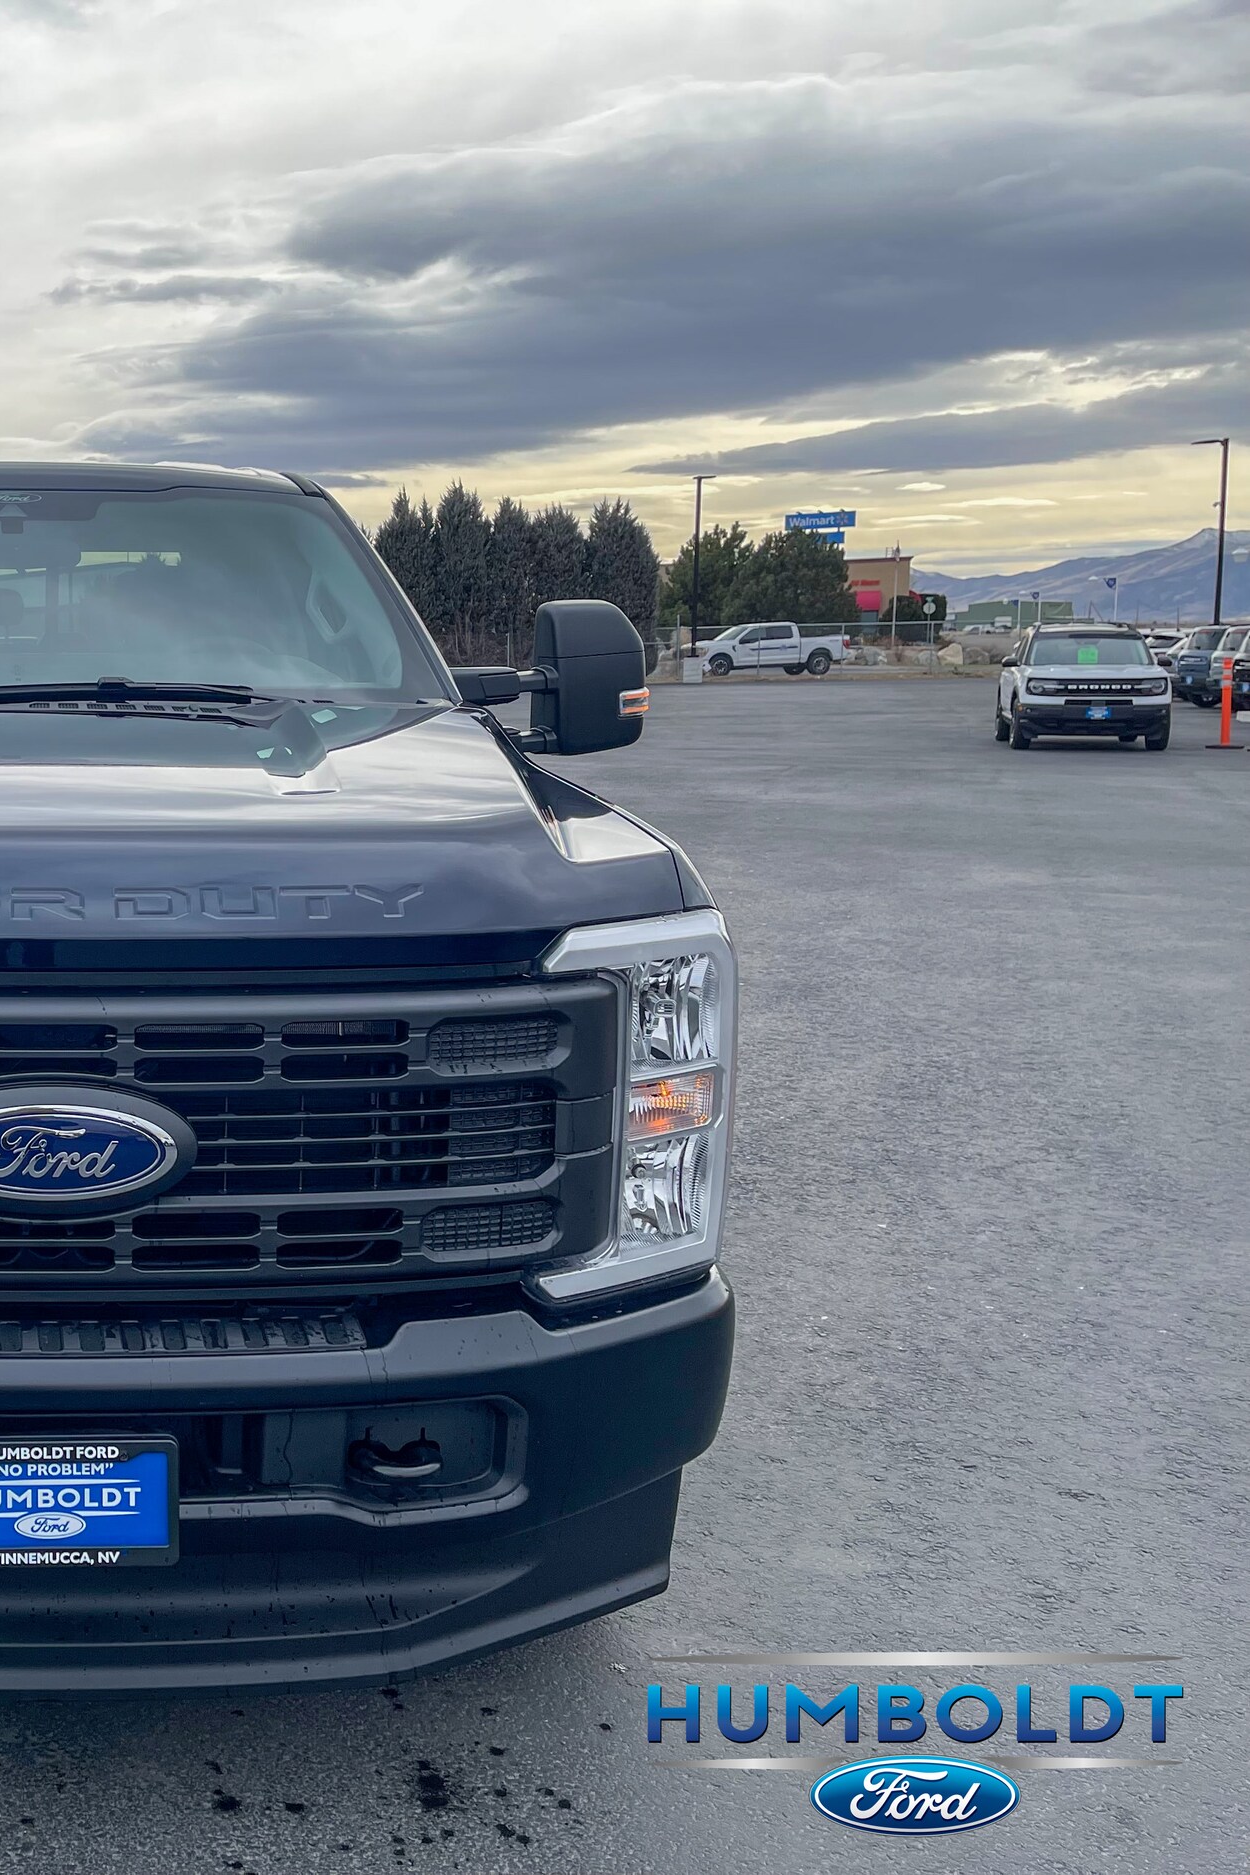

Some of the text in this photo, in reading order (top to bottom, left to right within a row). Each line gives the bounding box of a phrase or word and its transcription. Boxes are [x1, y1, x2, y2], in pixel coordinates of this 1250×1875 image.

[789, 515, 835, 527] Walmart
[112, 883, 425, 921] DUTY
[76, 1446, 119, 1460] FORD
[30, 1516, 70, 1534] Ford
[97, 1550, 121, 1564] NV
